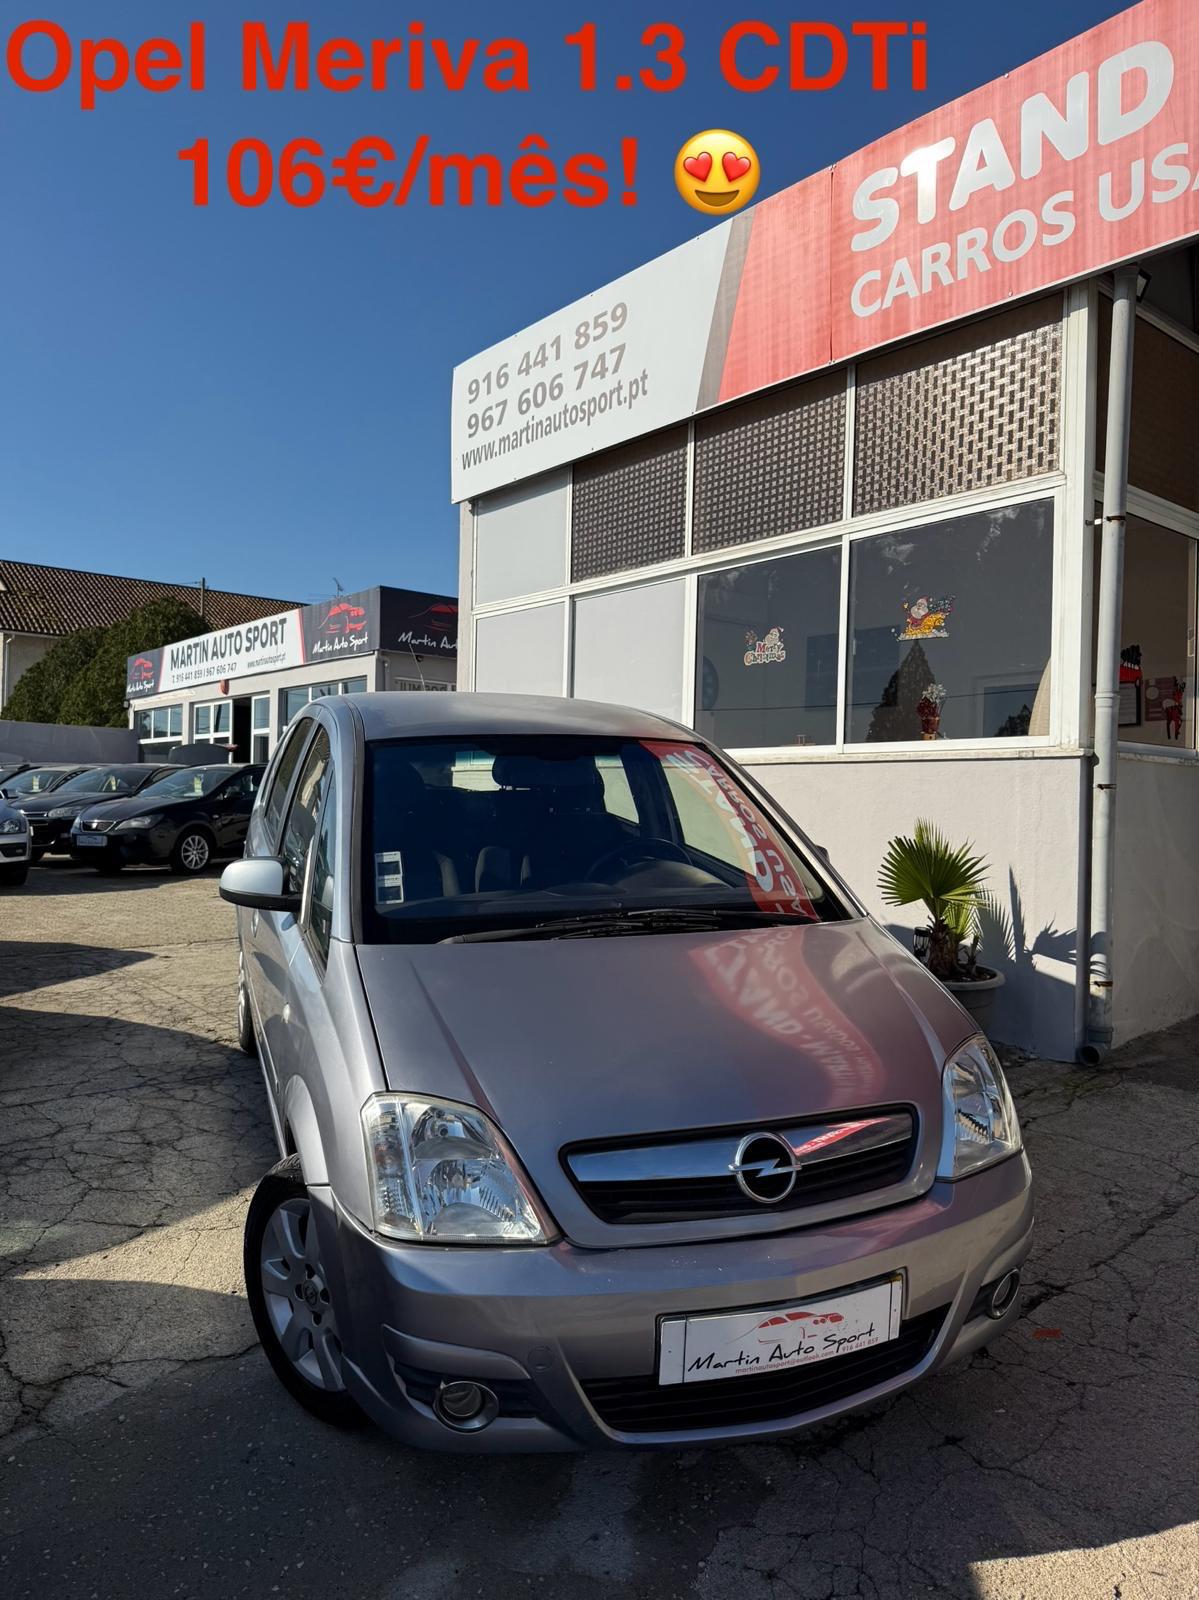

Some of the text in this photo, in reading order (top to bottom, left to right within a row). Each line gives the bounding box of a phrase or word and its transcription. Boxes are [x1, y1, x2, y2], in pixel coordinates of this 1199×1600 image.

[851, 41, 1174, 251] STAND
[851, 143, 1199, 318] CARROS US
[467, 343, 626, 438] 967 606 747
[468, 302, 628, 404] 916 441 859
[462, 368, 648, 470] www.martinautosport.pt
[170, 618, 287, 670] MARTIN AUTO SPORT
[312, 631, 368, 654] Martin Auto Sport
[398, 631, 436, 648] Martin
[688, 1323, 876, 1372] Martin Auto Sport
